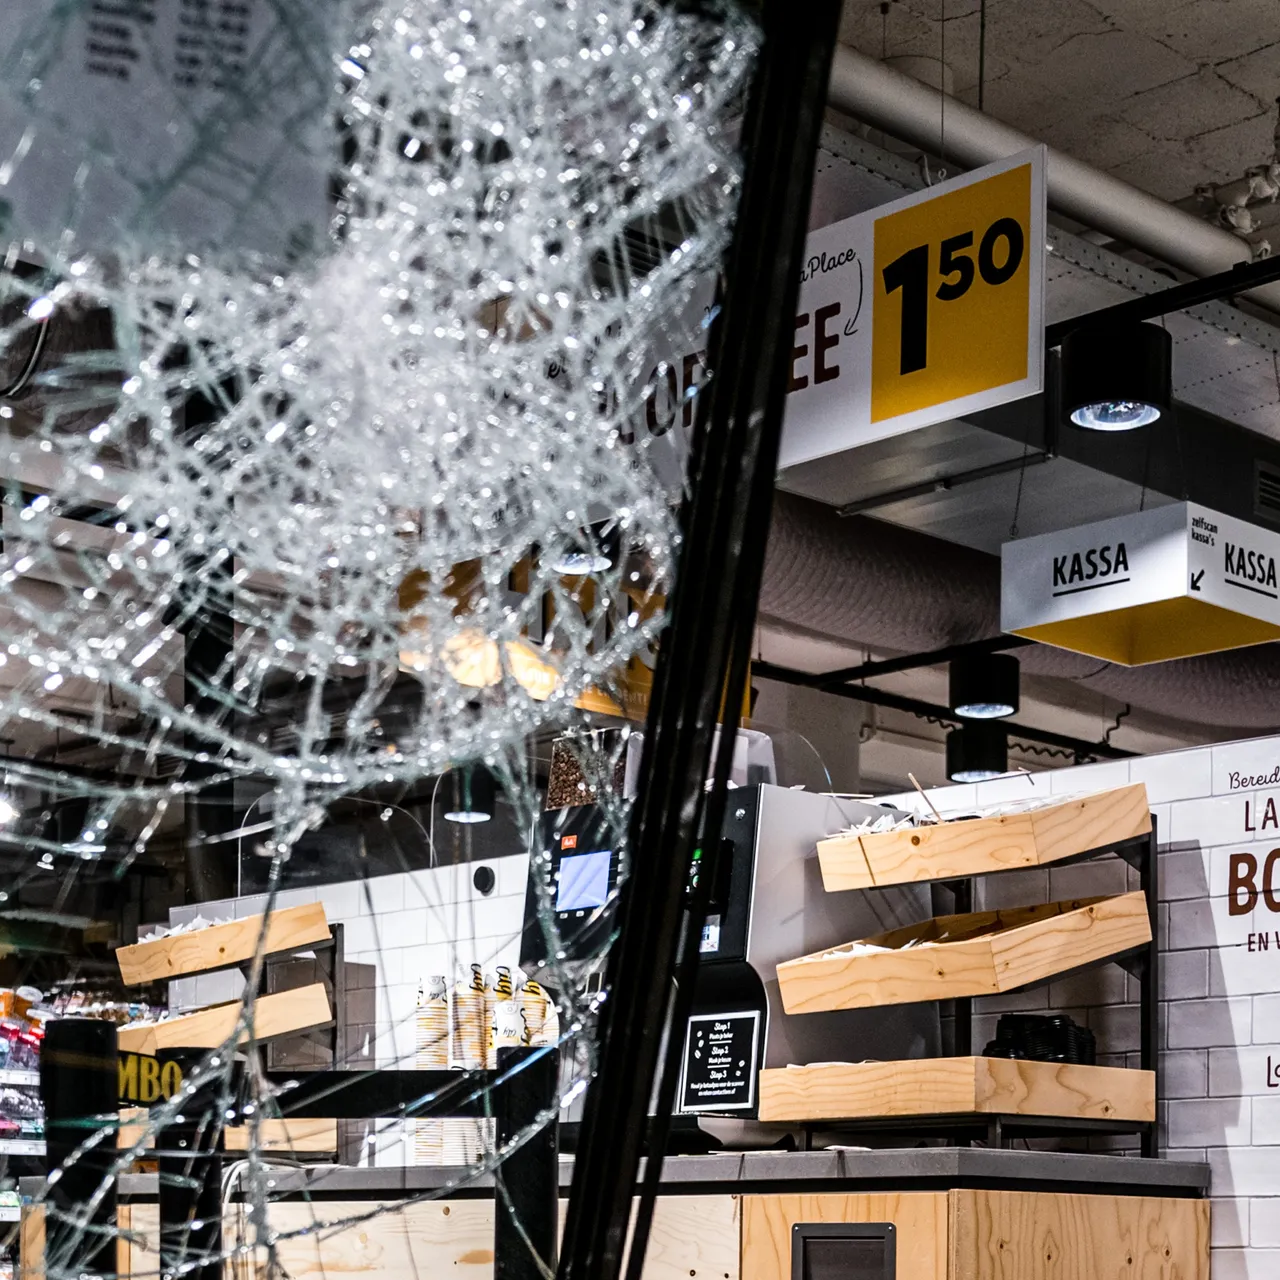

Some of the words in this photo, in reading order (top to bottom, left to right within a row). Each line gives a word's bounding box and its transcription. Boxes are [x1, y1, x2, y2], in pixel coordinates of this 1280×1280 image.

[807, 246, 856, 280] Place
[1191, 528, 1215, 547] kassa's
[1192, 516, 1218, 533] zelfscan
[1053, 543, 1129, 586] KASSA
[1225, 542, 1277, 588] KASSA
[1228, 767, 1280, 790] Bereid
[1245, 797, 1278, 832] LA
[1247, 932, 1269, 952] EN
[118, 1054, 183, 1102] MBO
